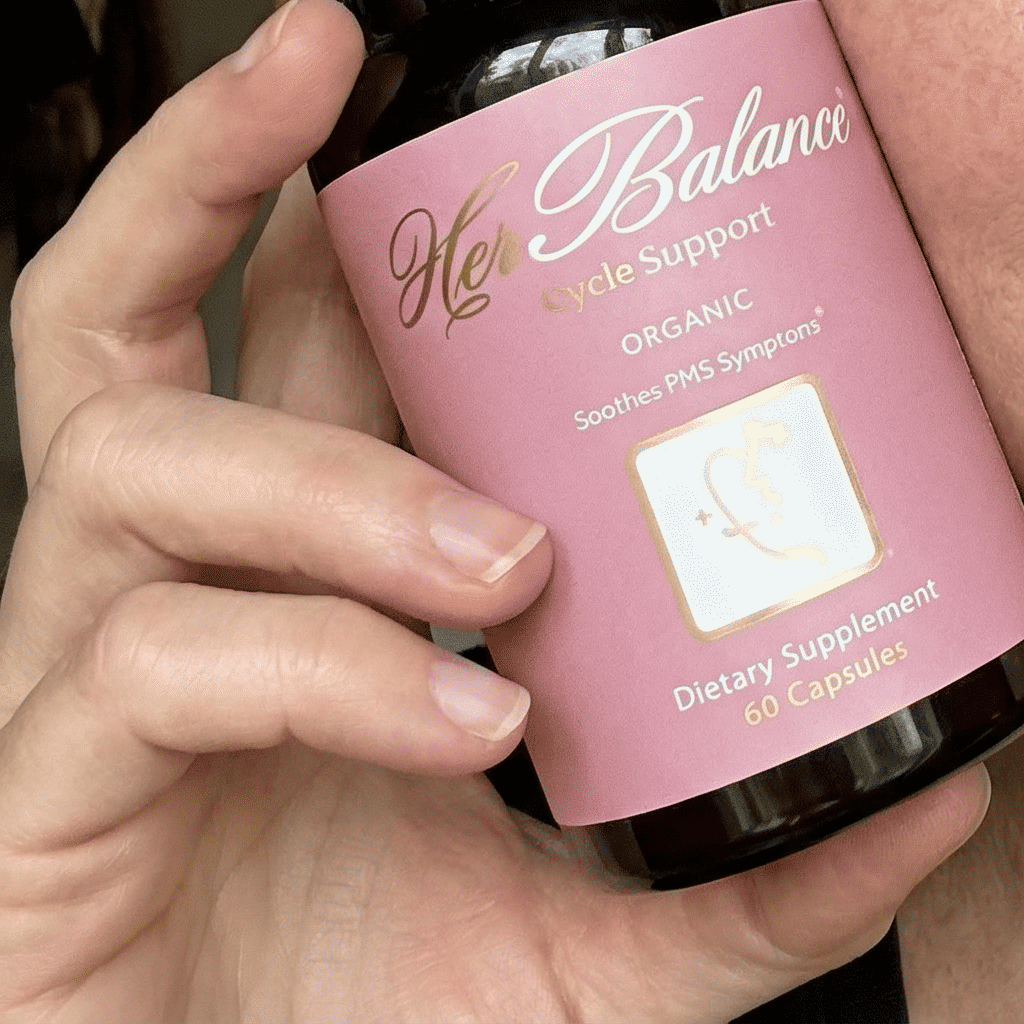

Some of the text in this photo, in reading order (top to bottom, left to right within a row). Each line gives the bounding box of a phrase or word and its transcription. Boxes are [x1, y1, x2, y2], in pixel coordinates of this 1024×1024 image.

[527, 85, 850, 262] Balance
[638, 202, 777, 275] Support
[620, 288, 754, 355] ORGANIC
[573, 385, 664, 431] Soothes
[664, 359, 715, 404] PMS
[672, 579, 940, 712] Dietary Supplement
[743, 640, 909, 727] 60 Capsules
